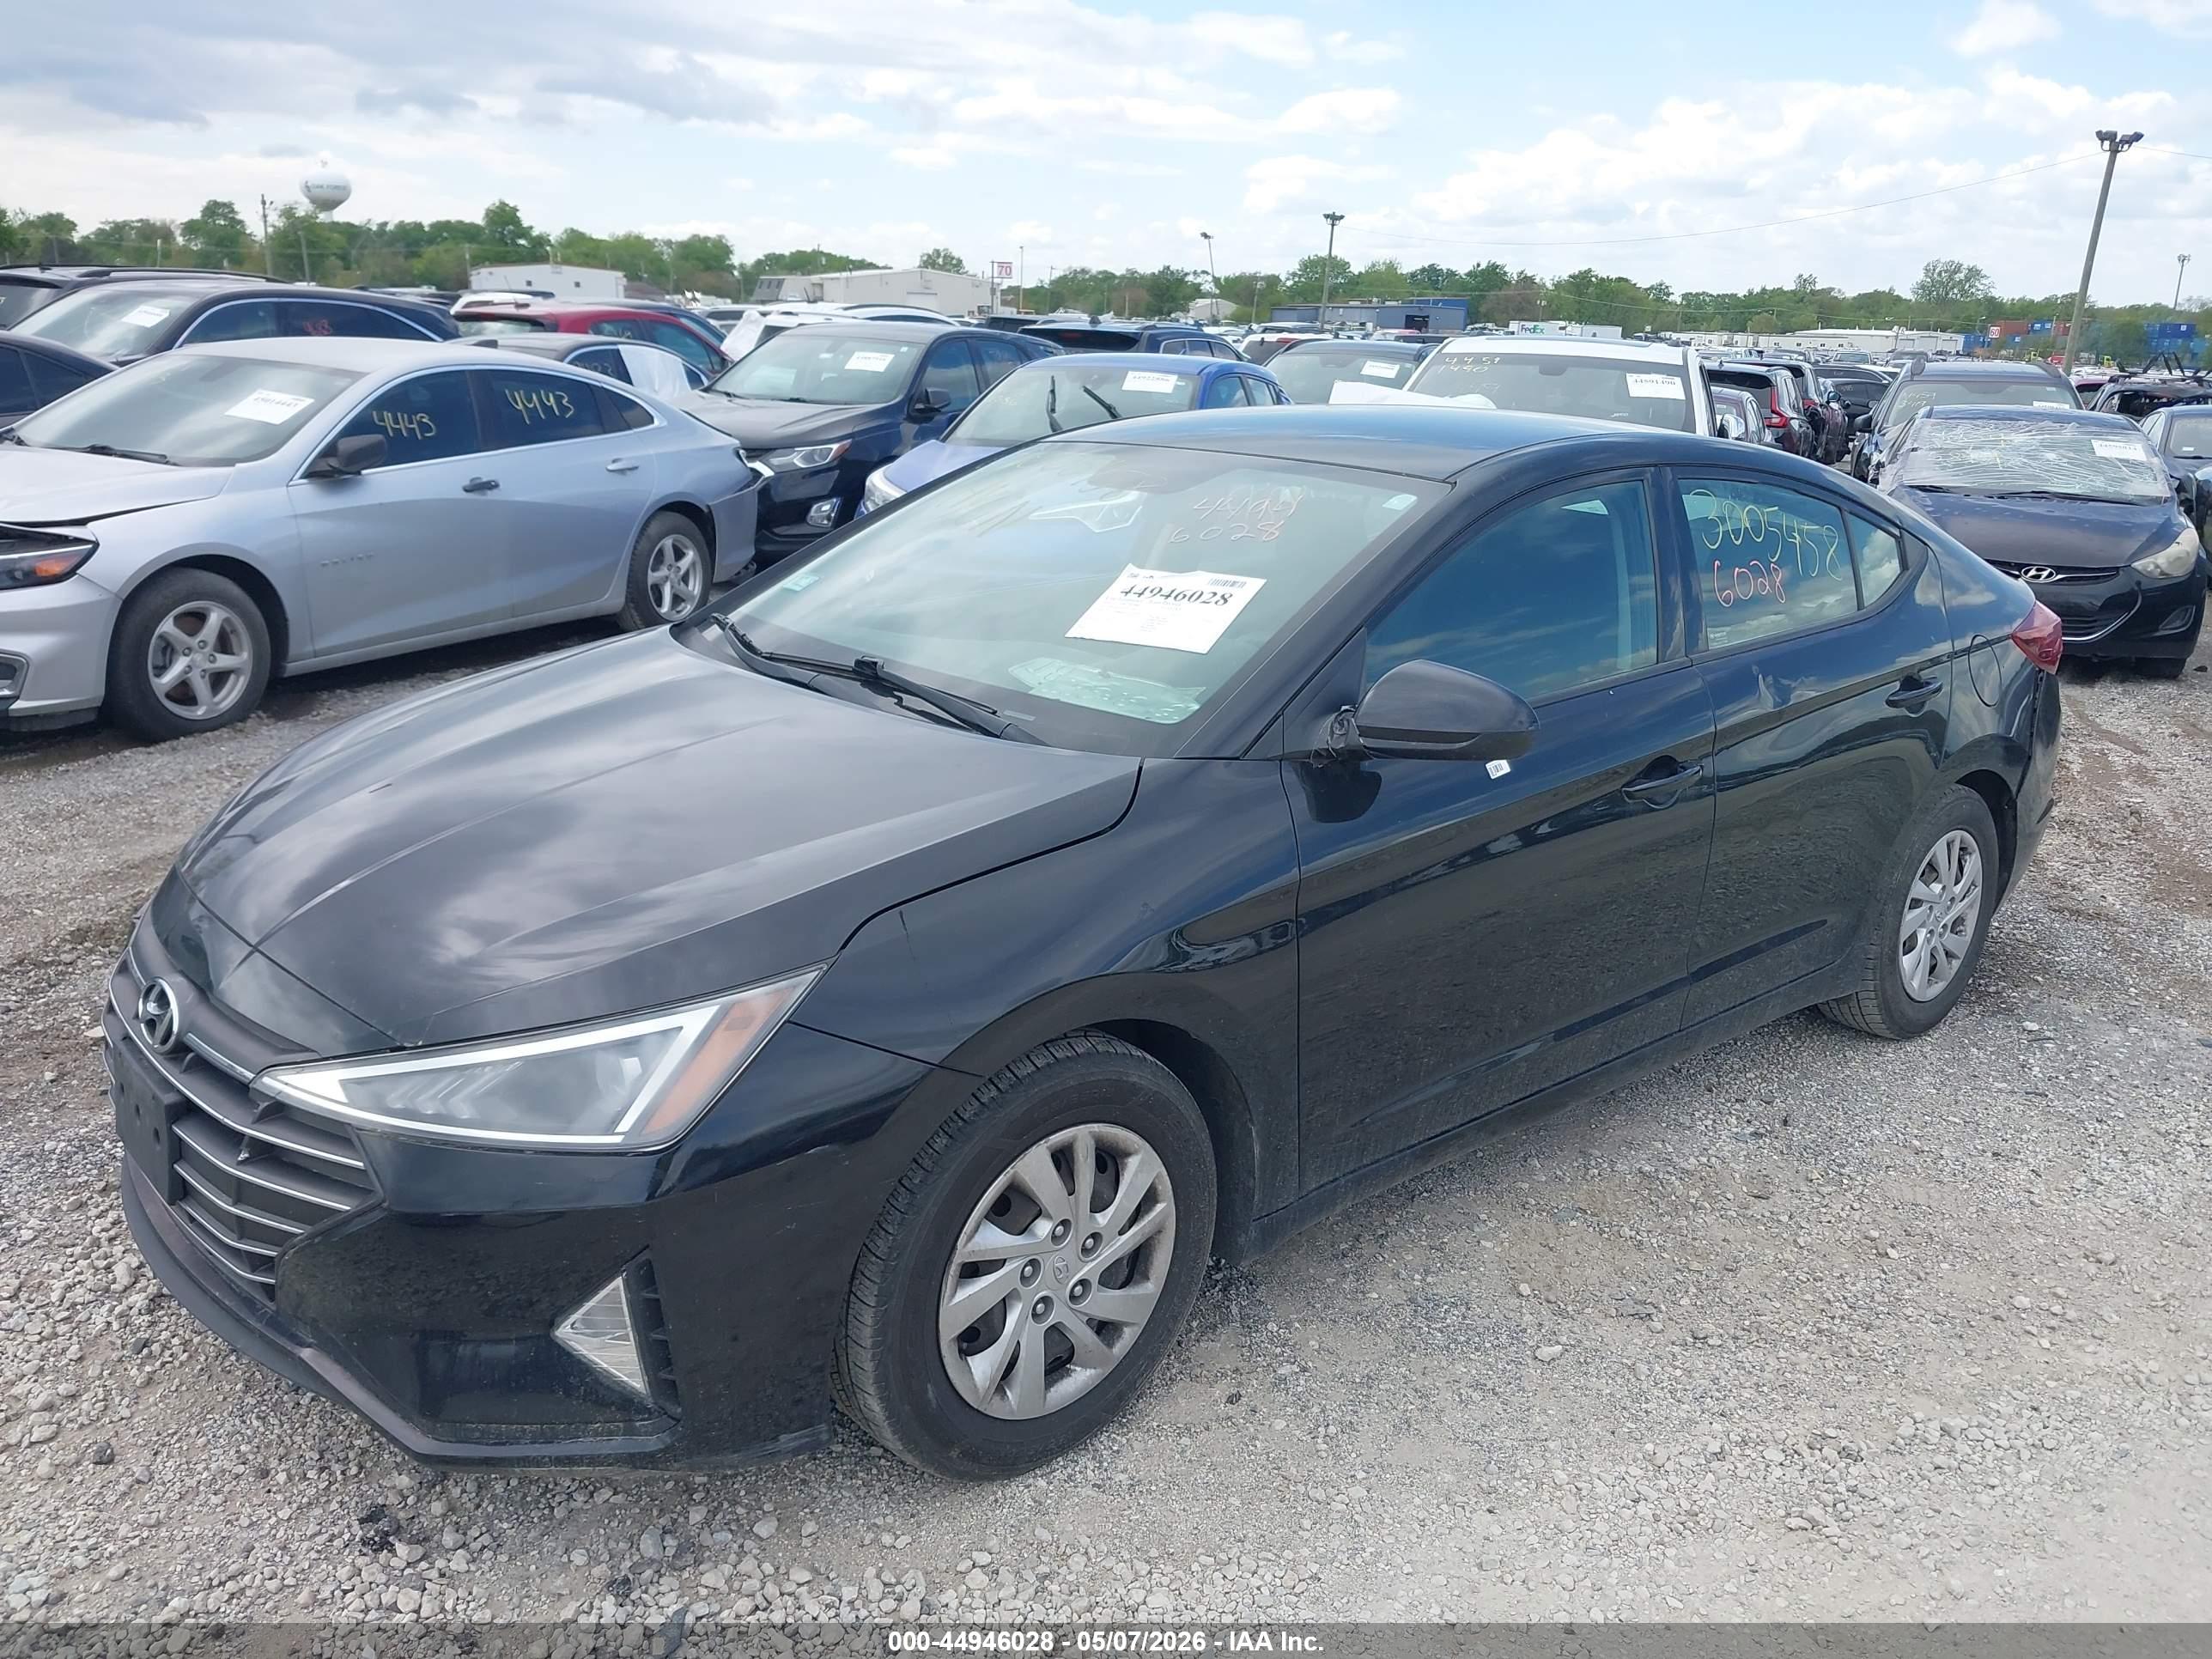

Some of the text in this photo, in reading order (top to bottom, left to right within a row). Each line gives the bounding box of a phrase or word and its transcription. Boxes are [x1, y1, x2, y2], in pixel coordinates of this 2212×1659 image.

[997, 265, 1012, 276] 70
[1521, 325, 1545, 334] FedEx
[1990, 328, 1999, 337] 60
[505, 388, 574, 424] 4443
[373, 410, 436, 440] 4443
[1168, 520, 1285, 544] 6028
[1689, 489, 1843, 581] 3005458
[1120, 584, 1234, 606] 44946028
[1713, 560, 1786, 607] 6028
